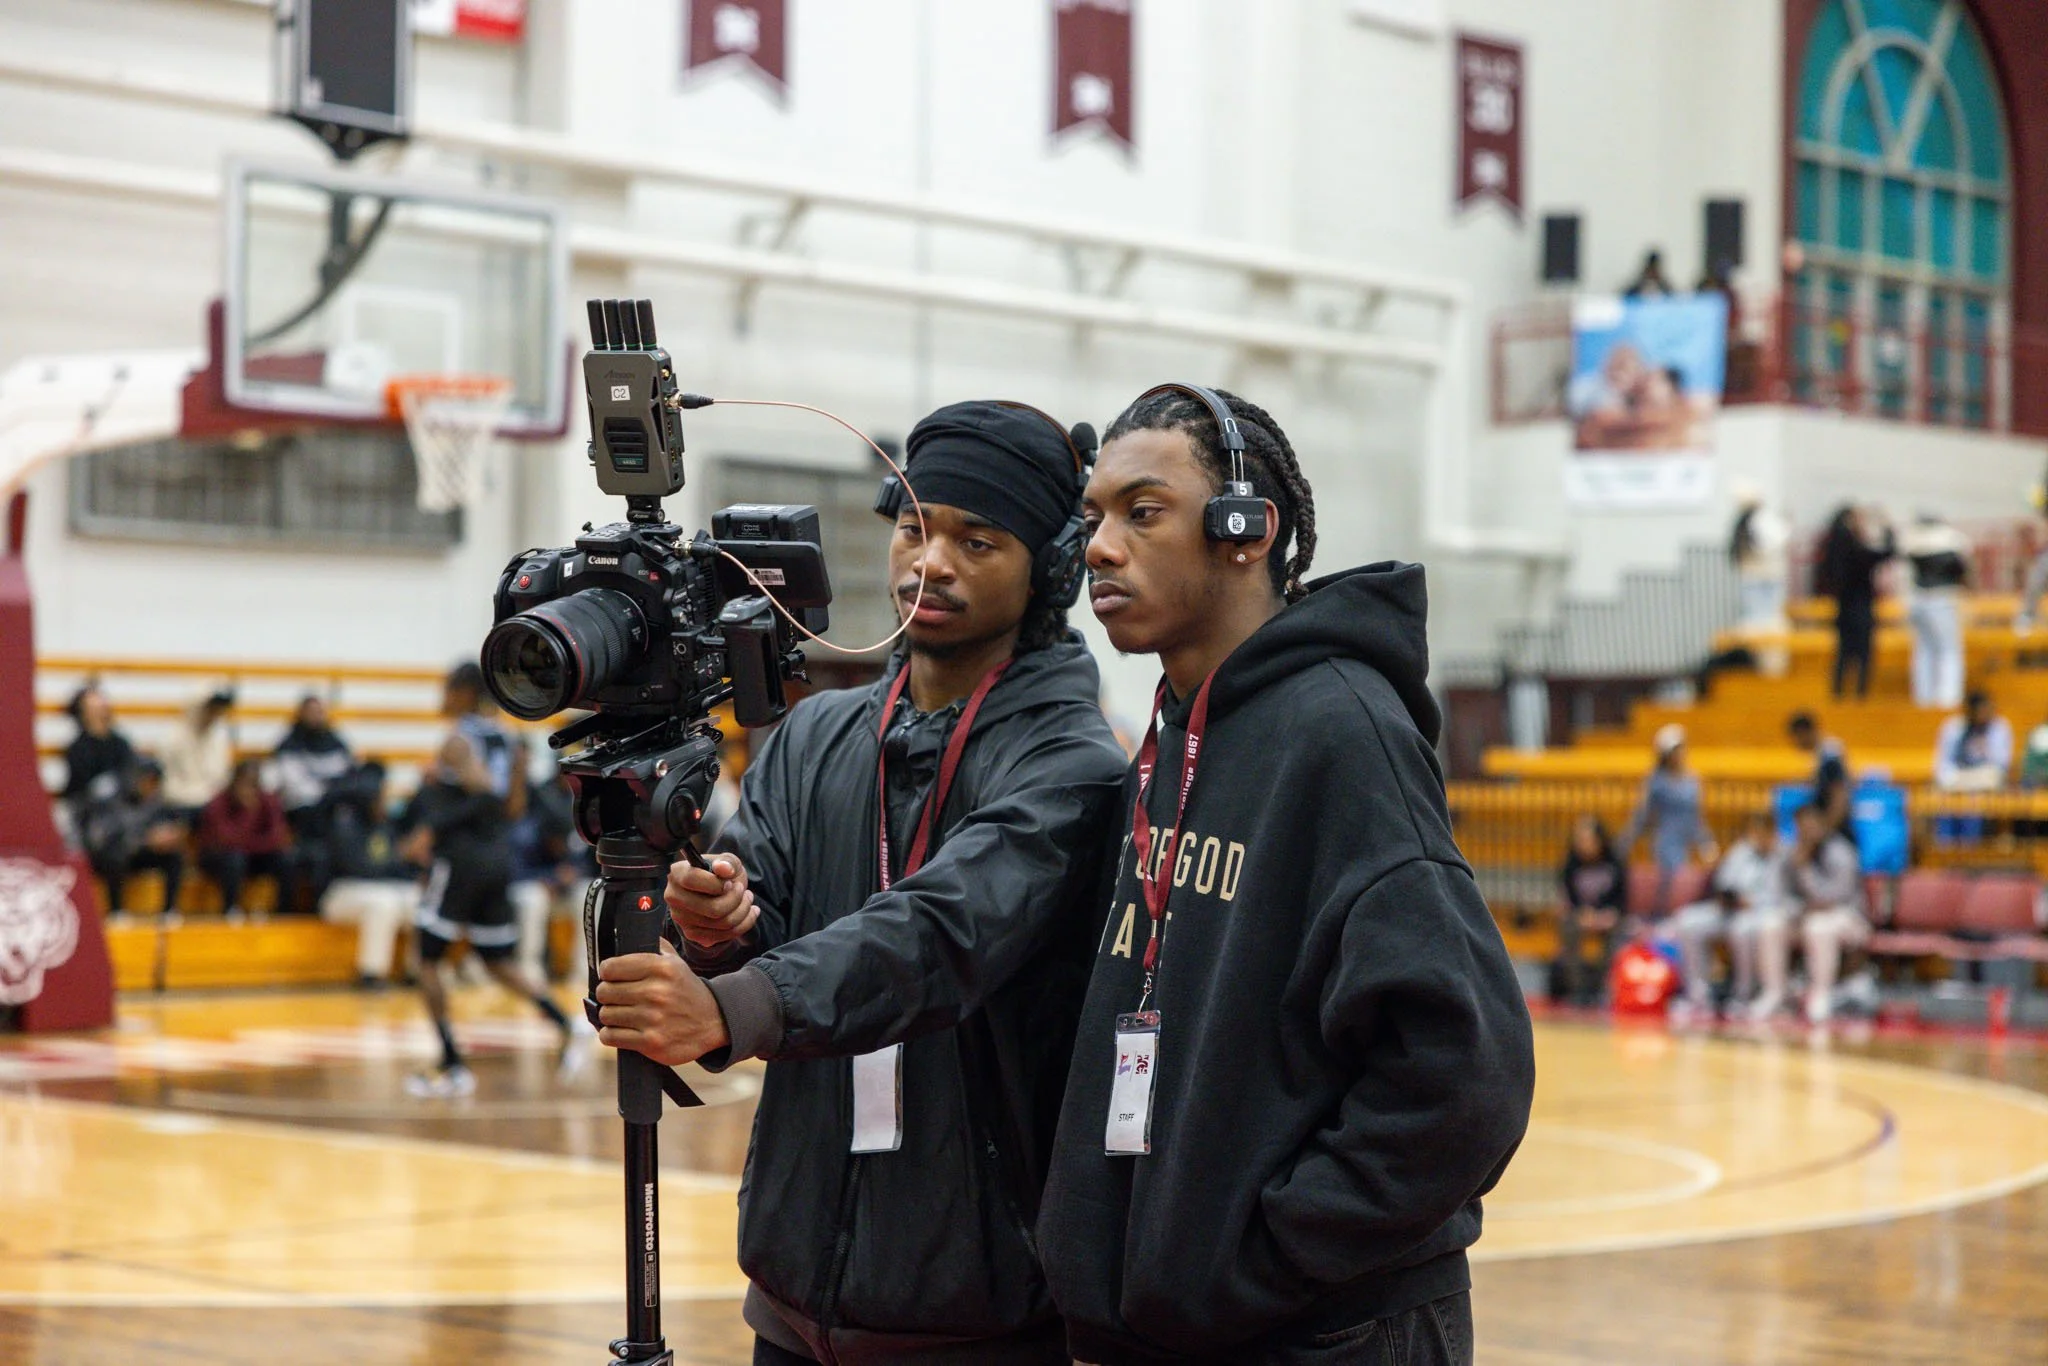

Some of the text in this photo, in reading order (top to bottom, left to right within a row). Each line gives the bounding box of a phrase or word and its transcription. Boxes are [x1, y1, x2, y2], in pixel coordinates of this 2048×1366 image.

[613, 388, 626, 399] C2
[1239, 483, 1248, 496] 5
[588, 555, 619, 565] Canon
[1188, 733, 1199, 759] 1867
[1118, 1113, 1135, 1122] STAFF
[645, 1183, 655, 1251] Manfrotto
